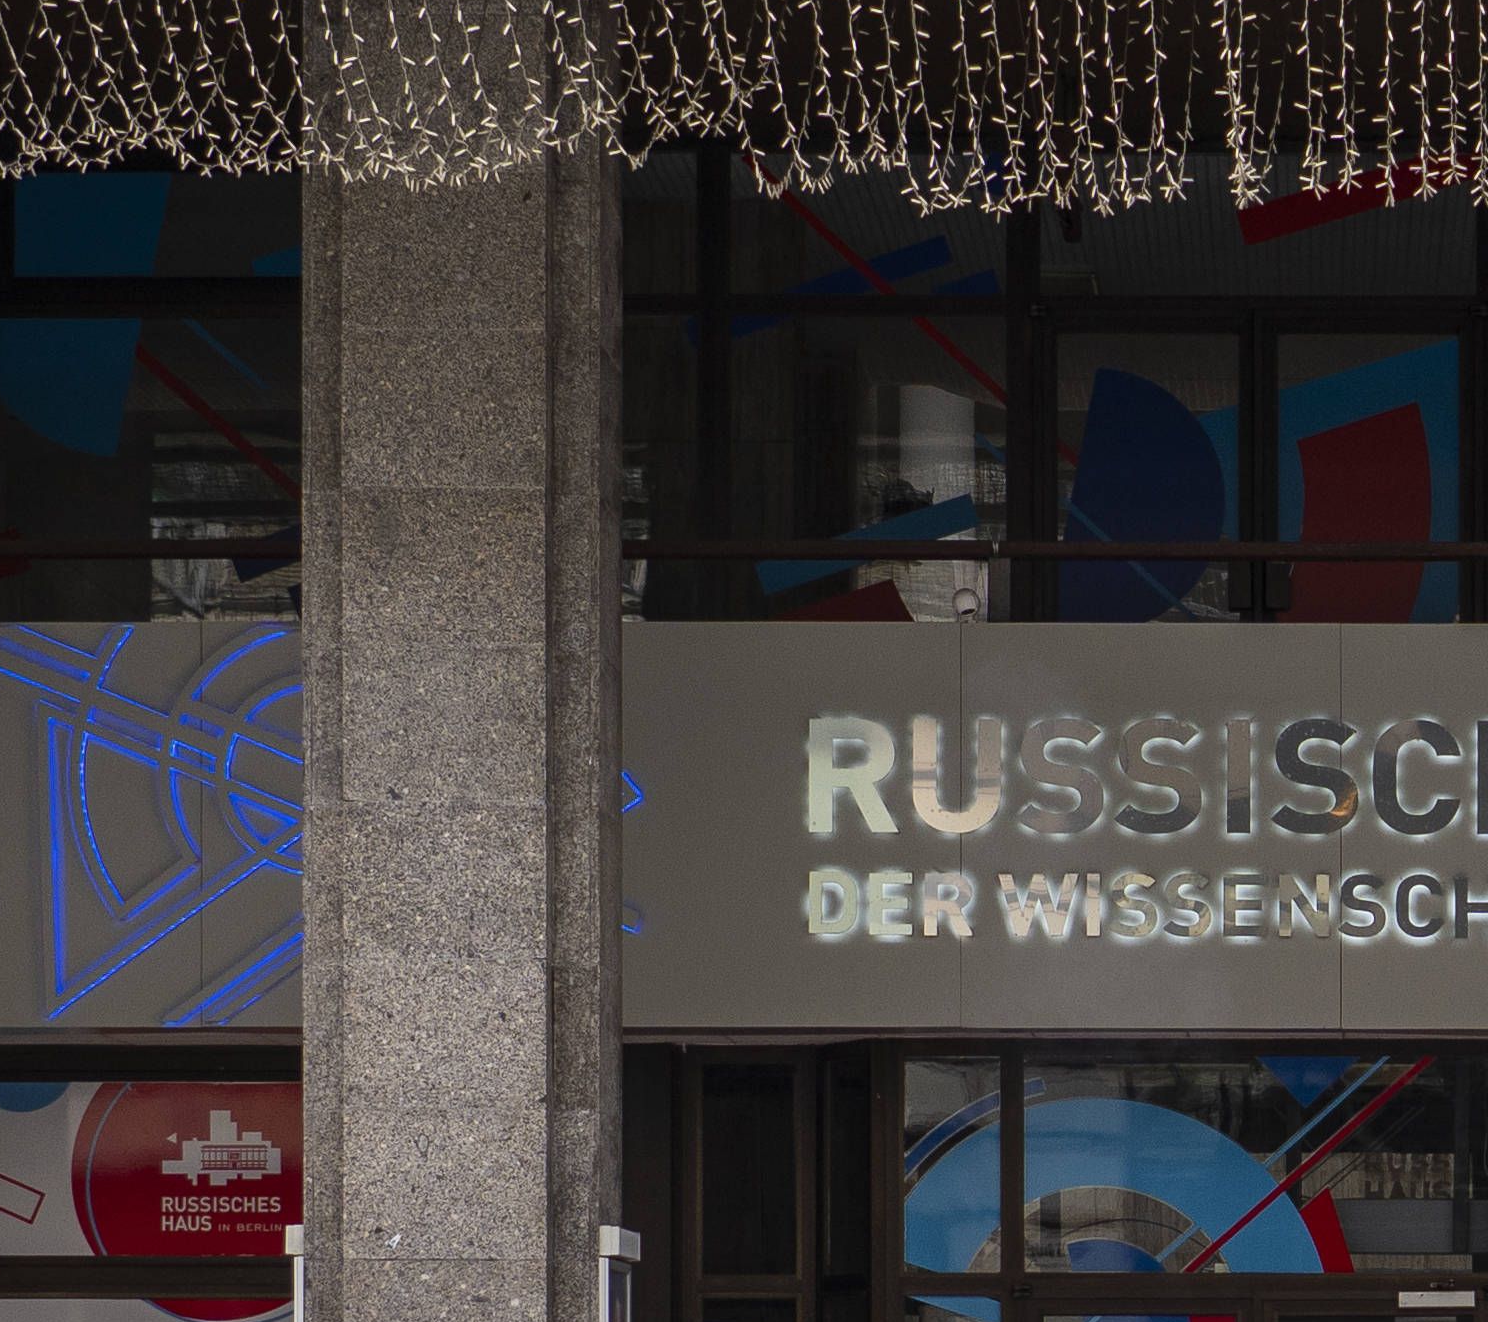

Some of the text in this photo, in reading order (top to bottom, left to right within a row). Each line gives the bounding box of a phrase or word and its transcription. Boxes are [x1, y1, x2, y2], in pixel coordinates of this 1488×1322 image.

[808, 871, 974, 937] DER
[161, 1196, 281, 1213] RUSSISCHES
[161, 1215, 282, 1232] HAUS IN BERLIN
